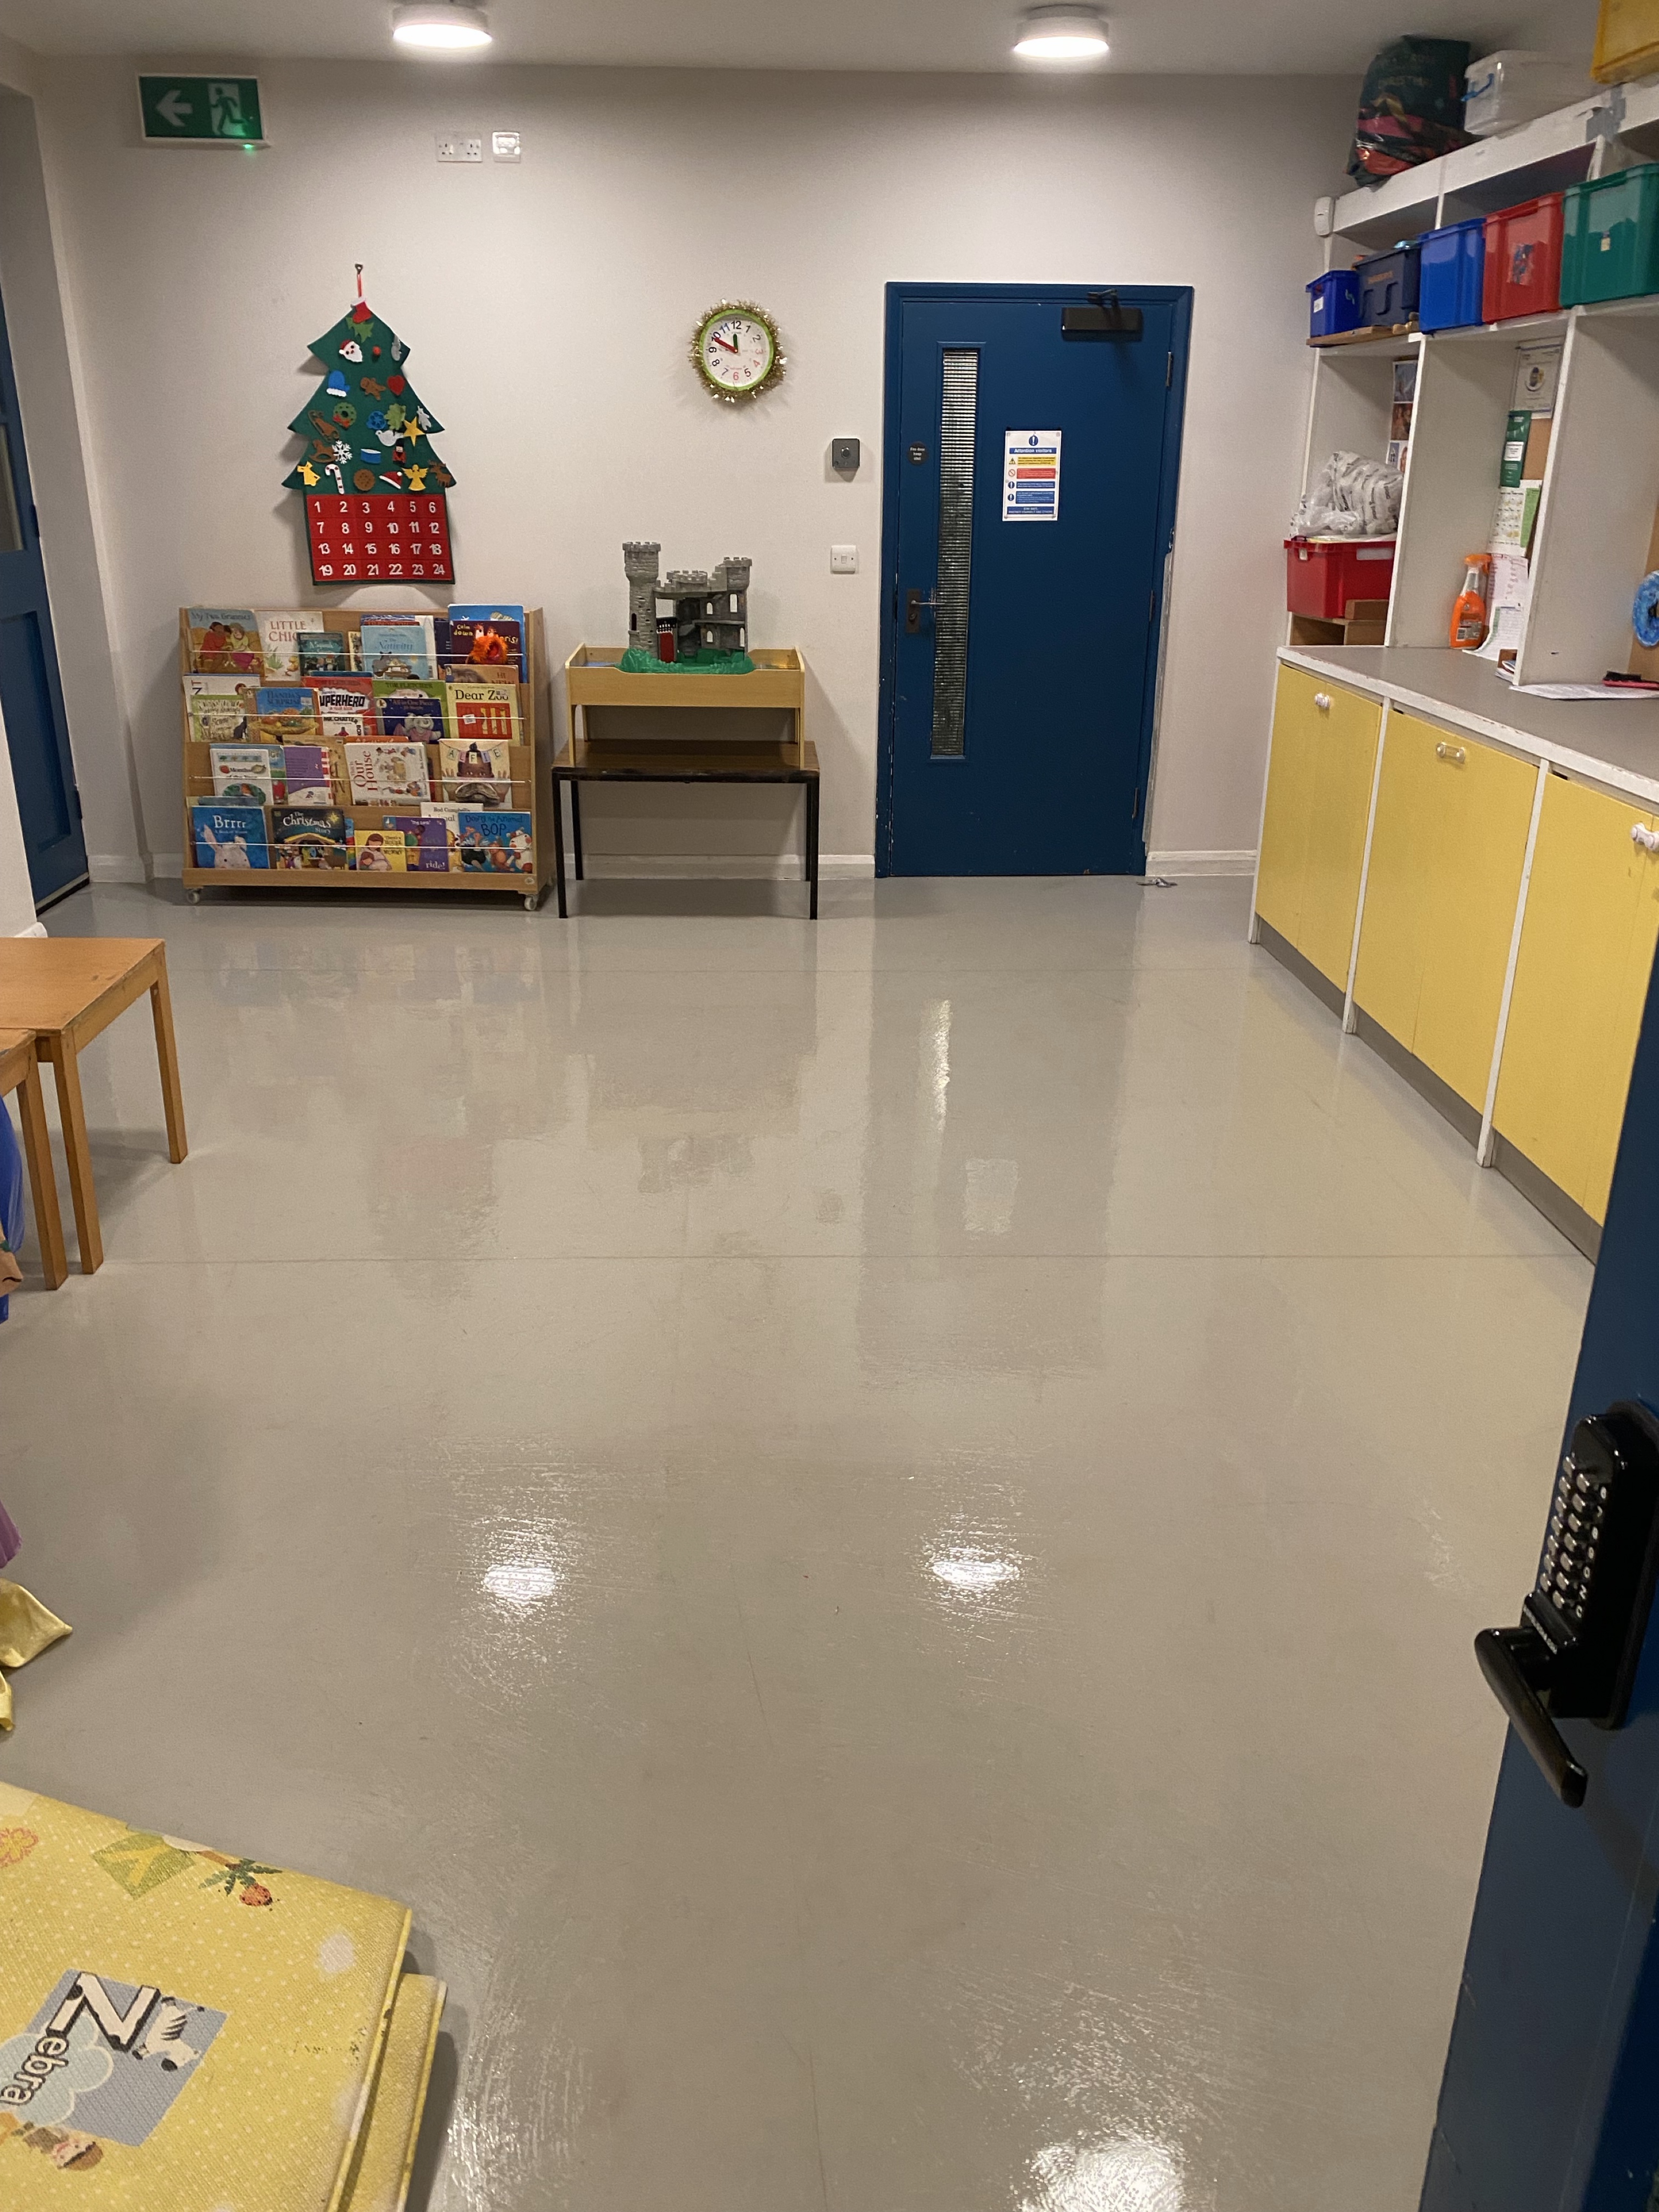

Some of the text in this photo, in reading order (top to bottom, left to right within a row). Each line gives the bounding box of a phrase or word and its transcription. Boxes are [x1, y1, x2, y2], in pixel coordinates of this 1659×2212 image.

[720, 323, 731, 334] 11
[731, 320, 742, 330] 12
[752, 334, 761, 343] 2
[753, 360, 761, 368] 4
[721, 367, 729, 376] 7
[733, 372, 739, 381] 6
[744, 368, 751, 377] 5
[314, 501, 436, 514] 1 2 3 4 5 6
[317, 522, 440, 534] 7 8 9 10 11 12
[318, 543, 442, 554] 13 14 15 16 17 18
[319, 564, 445, 577] 19 20 21 22 23 24
[270, 621, 306, 630] LITTLE
[320, 694, 365, 707] UPERHERO
[455, 690, 484, 700] Dear
[448, 748, 501, 762] ALFIE
[353, 760, 366, 787] Our
[363, 750, 378, 791] House
[283, 814, 331, 828] Christmas
[481, 823, 506, 836] BOP
[426, 860, 445, 870] ride!
